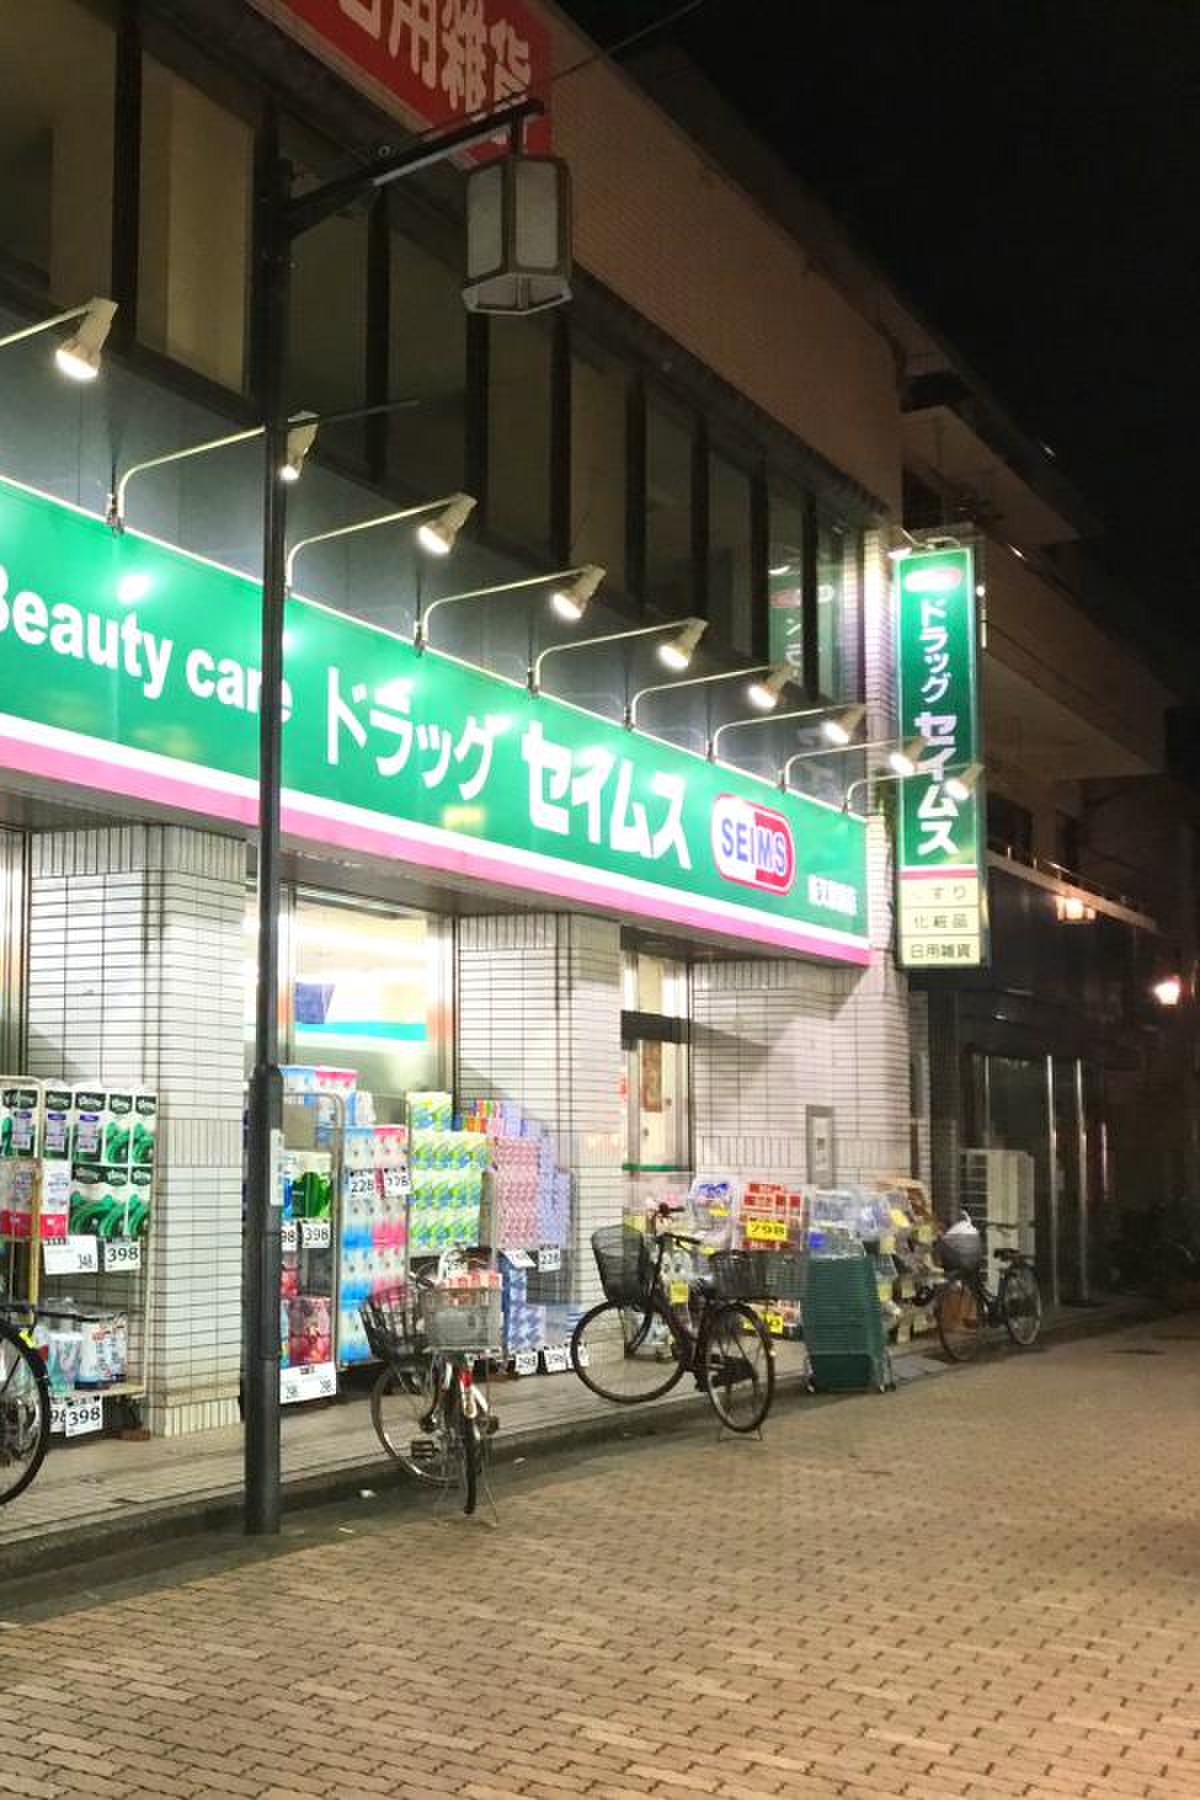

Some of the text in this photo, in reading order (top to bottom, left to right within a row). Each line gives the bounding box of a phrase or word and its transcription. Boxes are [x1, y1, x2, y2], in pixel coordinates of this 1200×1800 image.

[336, 0, 532, 121] 用雑貨
[913, 598, 960, 856] ドラッグ セイムス
[327, 666, 692, 870] ドラッグ セイムス
[720, 817, 786, 874] SEIMS
[913, 912, 969, 929] 化粧品
[910, 943, 971, 959] 日用雑貨
[106, 1246, 139, 1263] 398
[67, 1407, 101, 1427] 398
